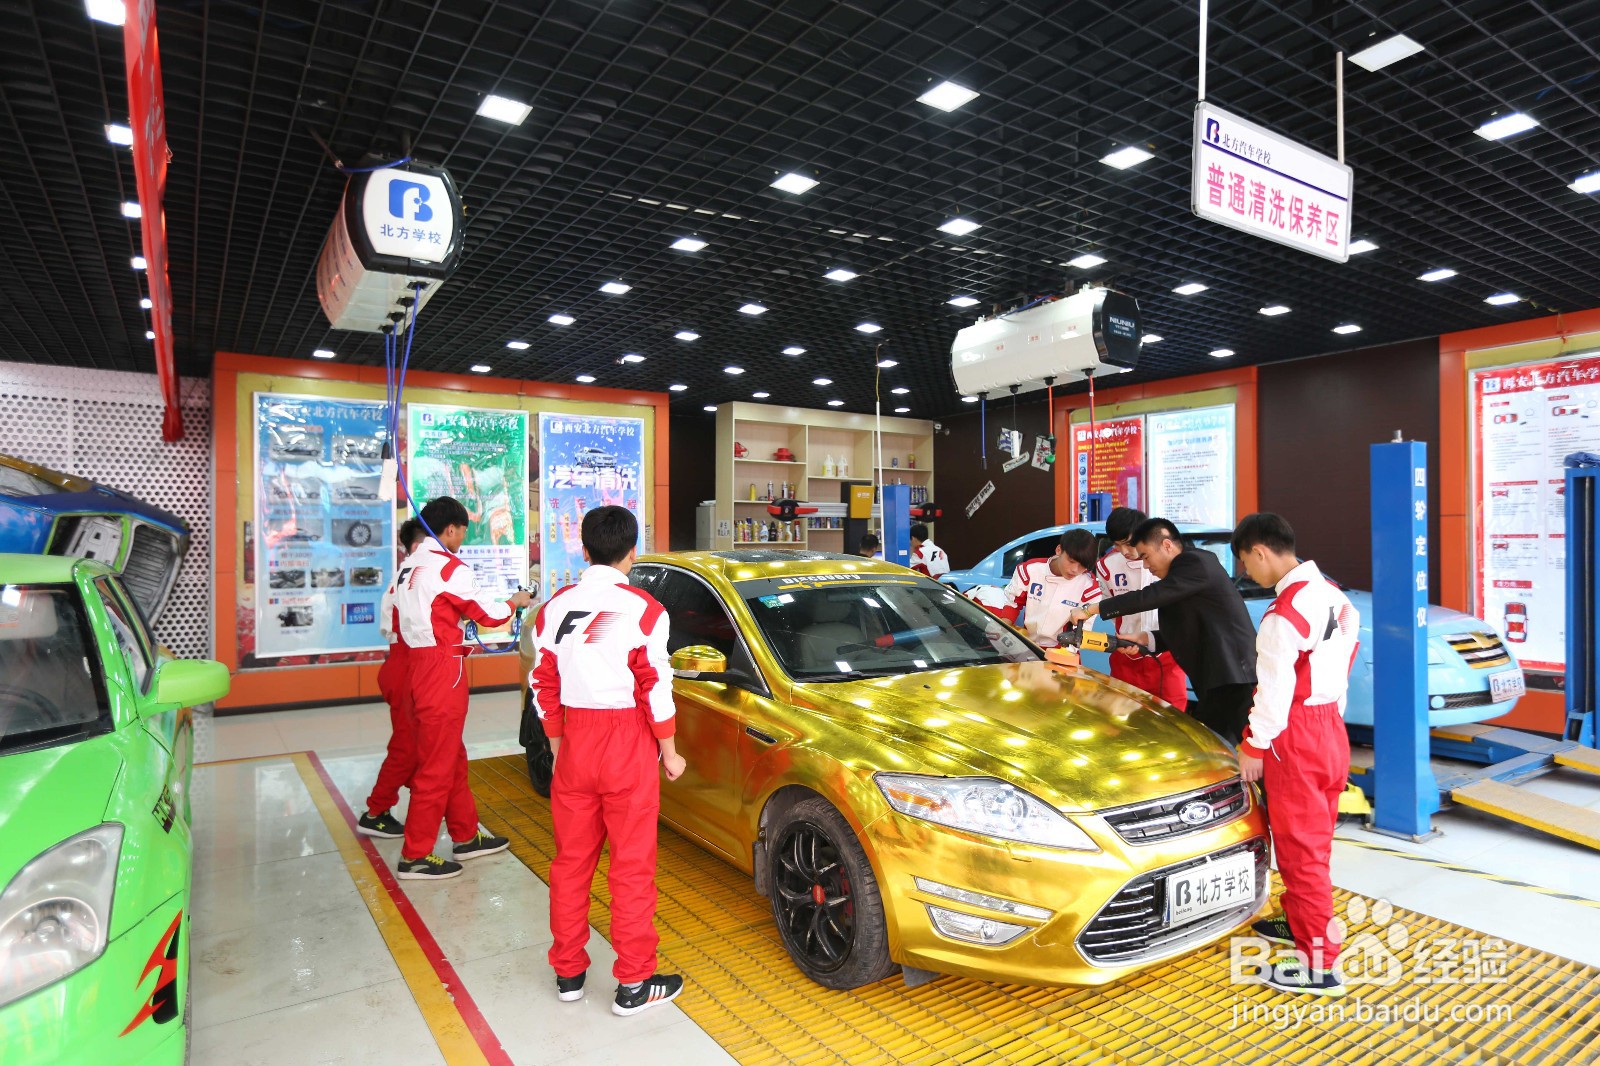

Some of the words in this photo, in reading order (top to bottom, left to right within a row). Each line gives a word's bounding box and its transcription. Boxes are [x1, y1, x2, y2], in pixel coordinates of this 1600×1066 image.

[1222, 133, 1271, 165] 北方汽车学校
[1207, 162, 1339, 246] 普通清洗保养区
[380, 223, 442, 245] 北方学校
[564, 423, 635, 437] 西安北方汽车学校
[548, 464, 637, 491] 汽车清洗
[1414, 467, 1428, 628] 四轮定位仪
[554, 610, 626, 645] F1
[1196, 867, 1250, 906] 北方学校
